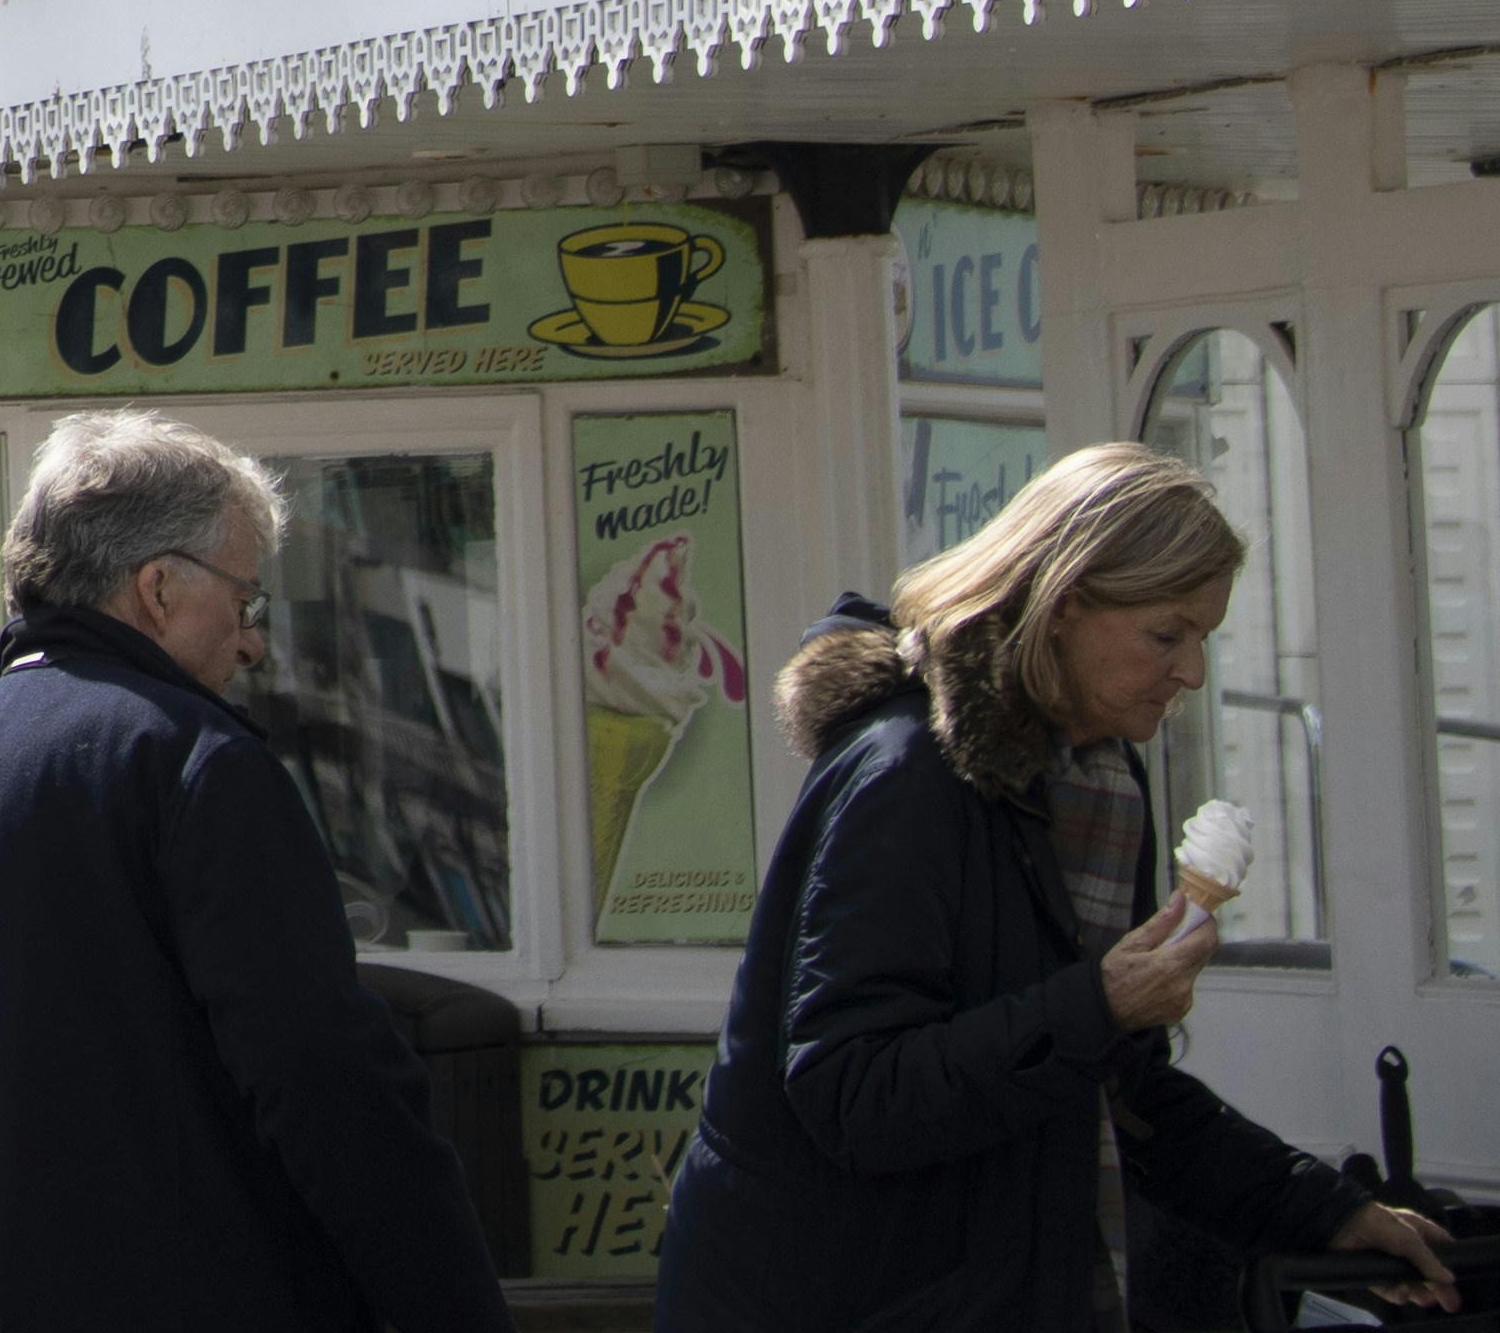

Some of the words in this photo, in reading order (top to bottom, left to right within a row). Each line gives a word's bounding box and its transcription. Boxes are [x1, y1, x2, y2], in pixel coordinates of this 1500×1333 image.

[51, 219, 493, 378] COFFEE
[932, 253, 1003, 363] ICE
[362, 348, 468, 376] SERVED
[471, 345, 548, 373] HERE
[579, 430, 729, 501] Freshly
[595, 479, 712, 540] made!
[611, 893, 754, 915] REFRESHING
[634, 871, 730, 889] DELICIOUS
[733, 872, 745, 885] &
[539, 1068, 706, 1111] DRINK
[533, 1129, 689, 1180] SERV
[553, 1189, 671, 1256] HE
